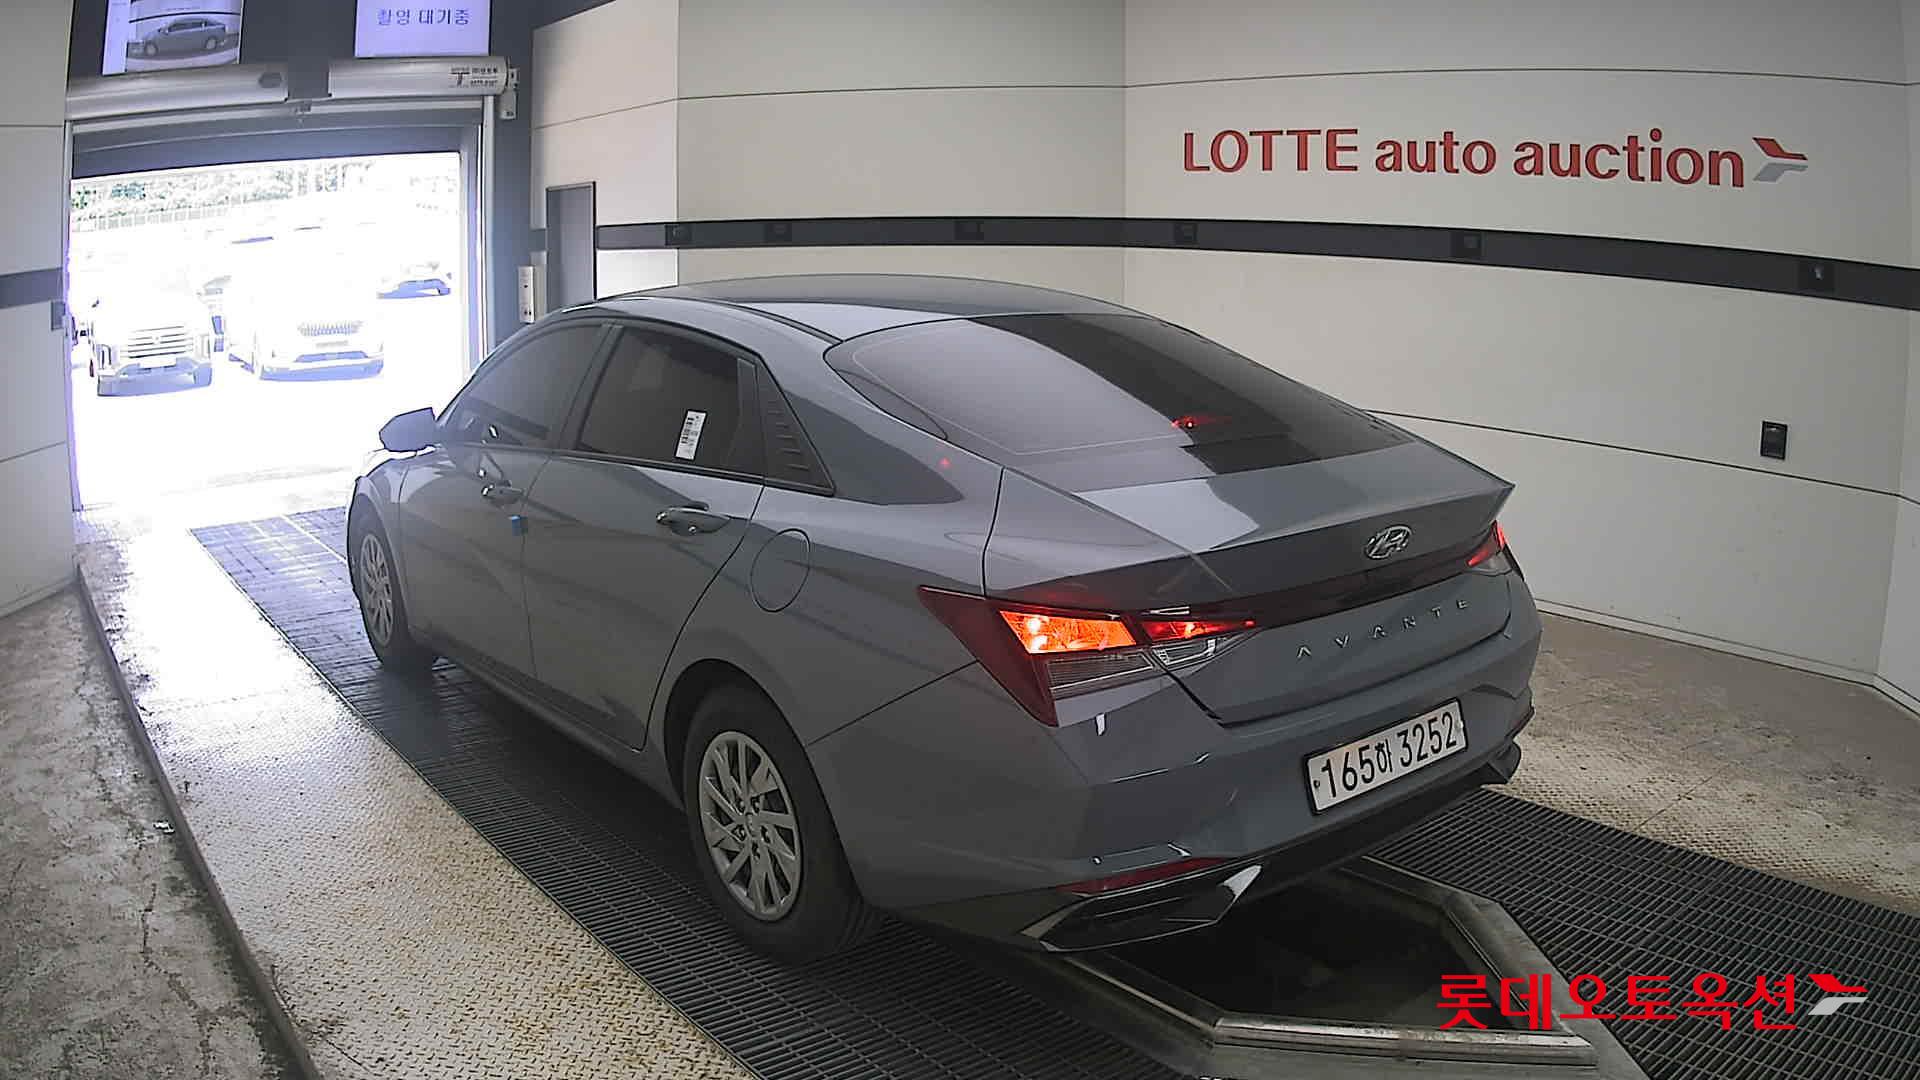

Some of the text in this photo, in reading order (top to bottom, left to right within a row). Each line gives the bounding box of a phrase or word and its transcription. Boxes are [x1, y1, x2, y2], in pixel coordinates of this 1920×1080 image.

[418, 8, 470, 26] 대기중
[1184, 128, 1745, 188] LOTTE auto auction
[1296, 599, 1468, 660] AVANTE
[1321, 711, 1457, 798] 165하 3252
